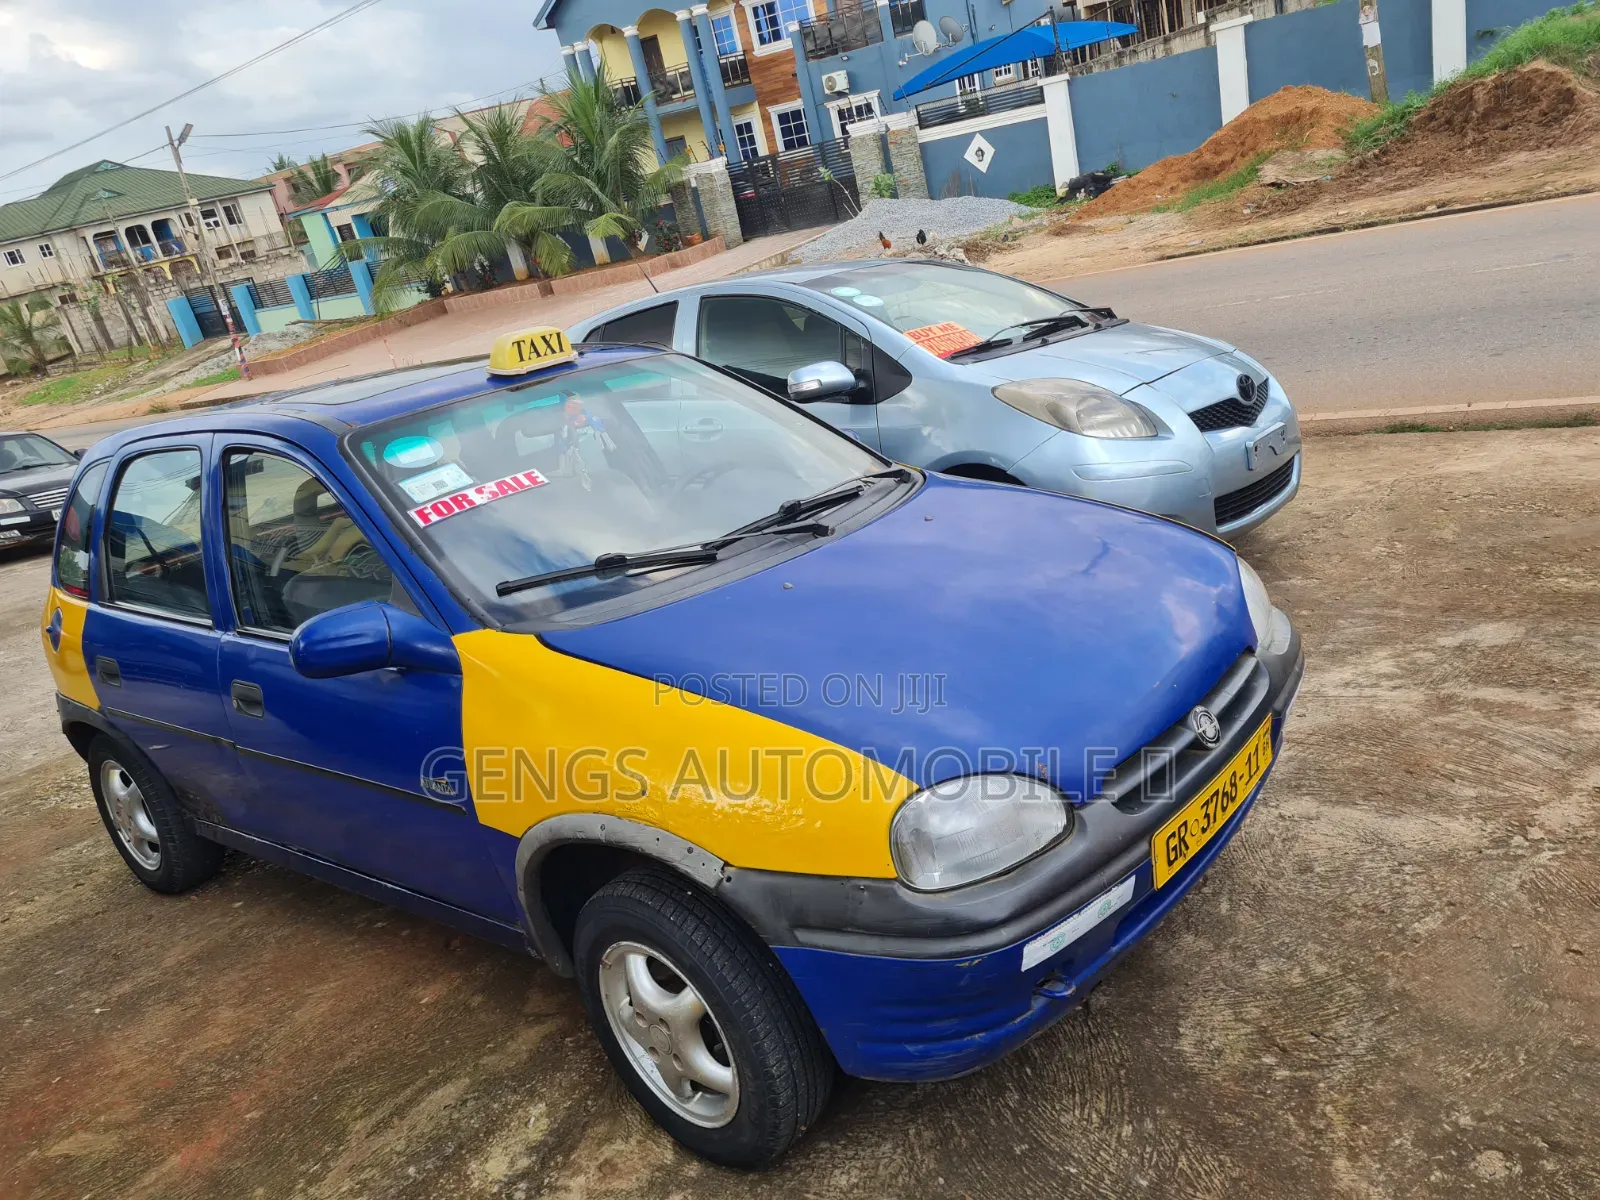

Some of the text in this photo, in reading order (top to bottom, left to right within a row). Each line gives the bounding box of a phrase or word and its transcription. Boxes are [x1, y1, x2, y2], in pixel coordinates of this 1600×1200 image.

[512, 332, 565, 362] TAXI
[907, 322, 960, 340] BUY ME
[414, 493, 477, 525] FOR
[474, 471, 545, 500] SALE
[1166, 742, 1261, 867] GR 3768-11
